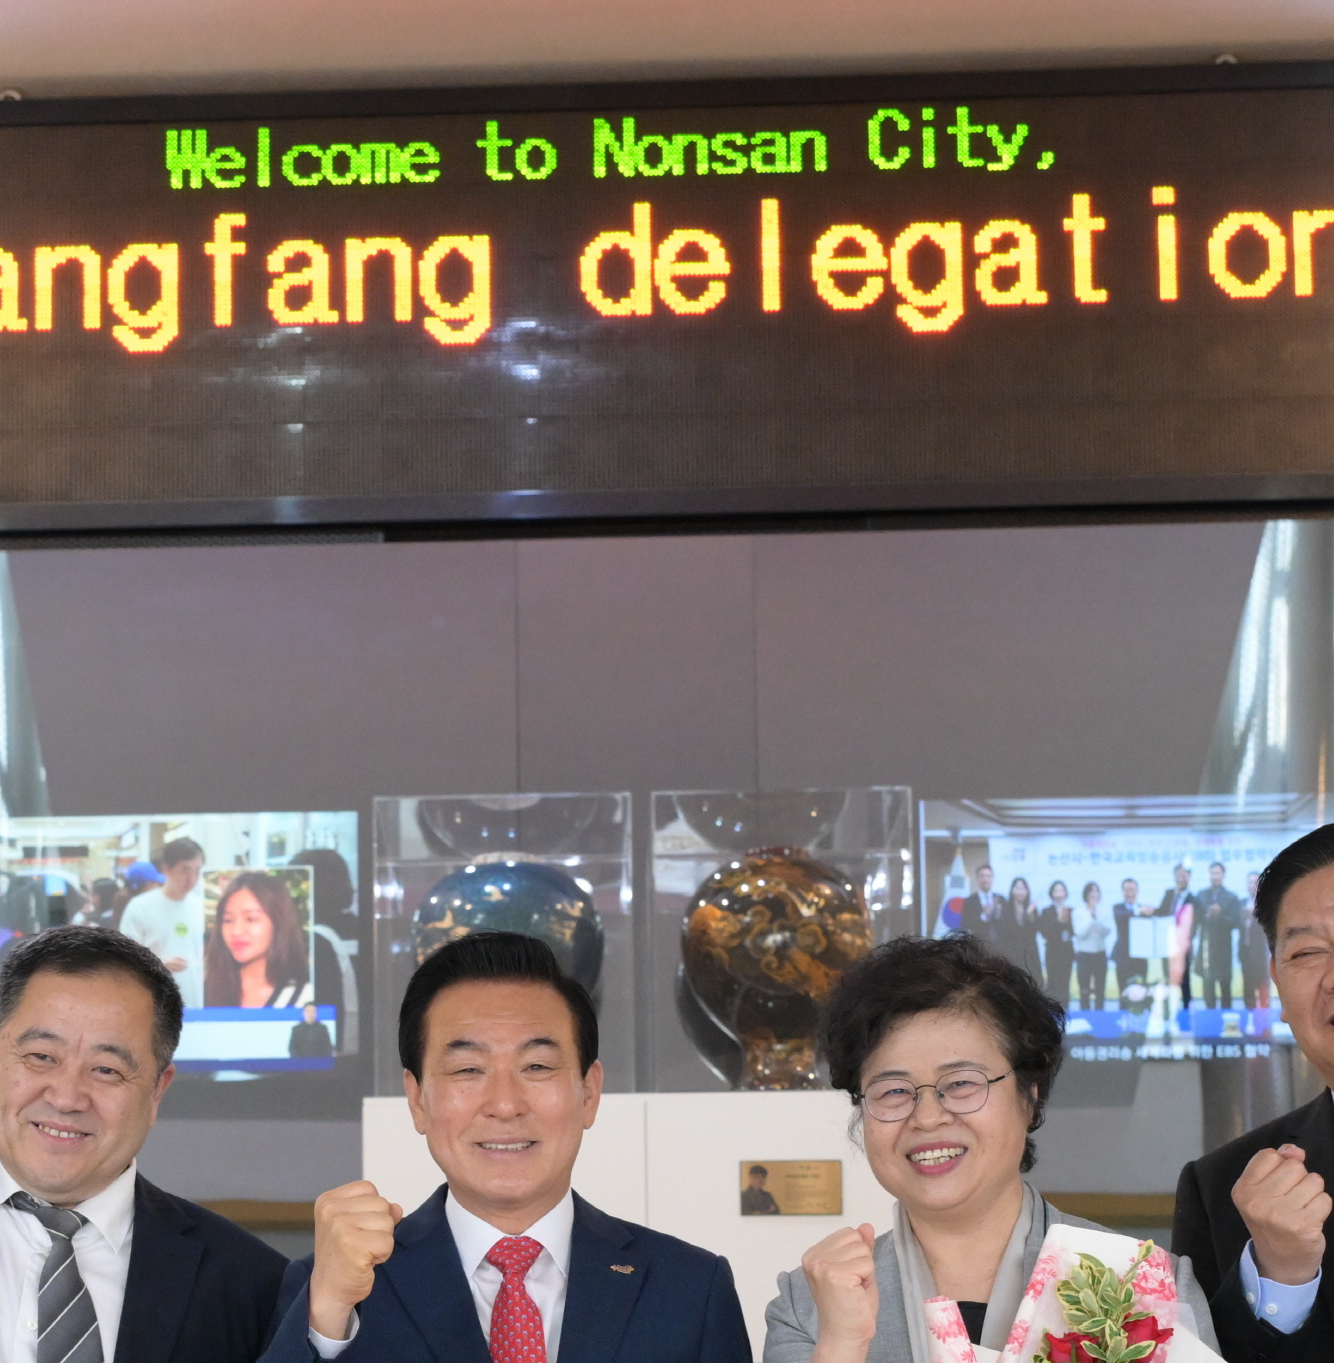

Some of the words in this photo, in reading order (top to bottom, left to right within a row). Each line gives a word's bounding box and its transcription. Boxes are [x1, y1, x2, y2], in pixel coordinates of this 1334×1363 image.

[165, 125, 441, 190] Welcome
[475, 119, 558, 182] to
[591, 115, 829, 178] Nonsan
[866, 105, 1056, 172] City,
